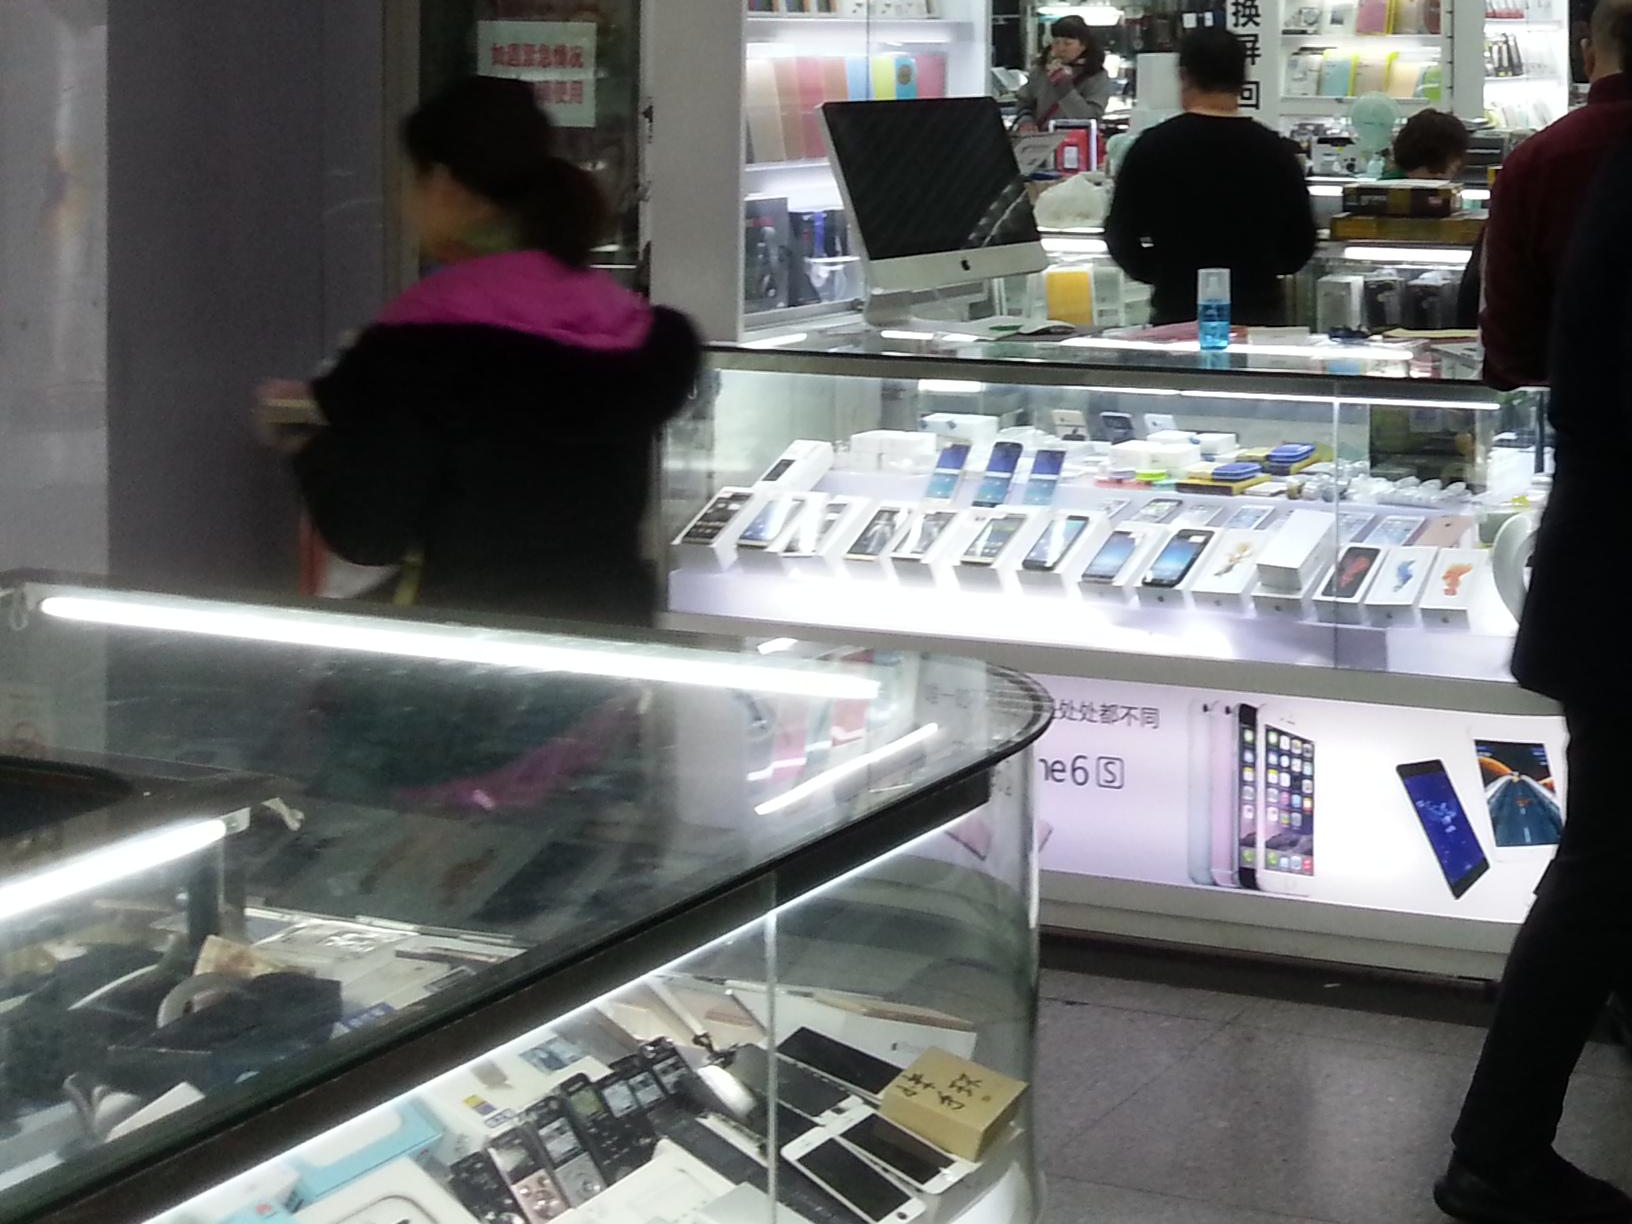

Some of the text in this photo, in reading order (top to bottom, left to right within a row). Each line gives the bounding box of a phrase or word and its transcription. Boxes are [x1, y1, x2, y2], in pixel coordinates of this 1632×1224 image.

[1053, 698, 1160, 729] 处处都不同
